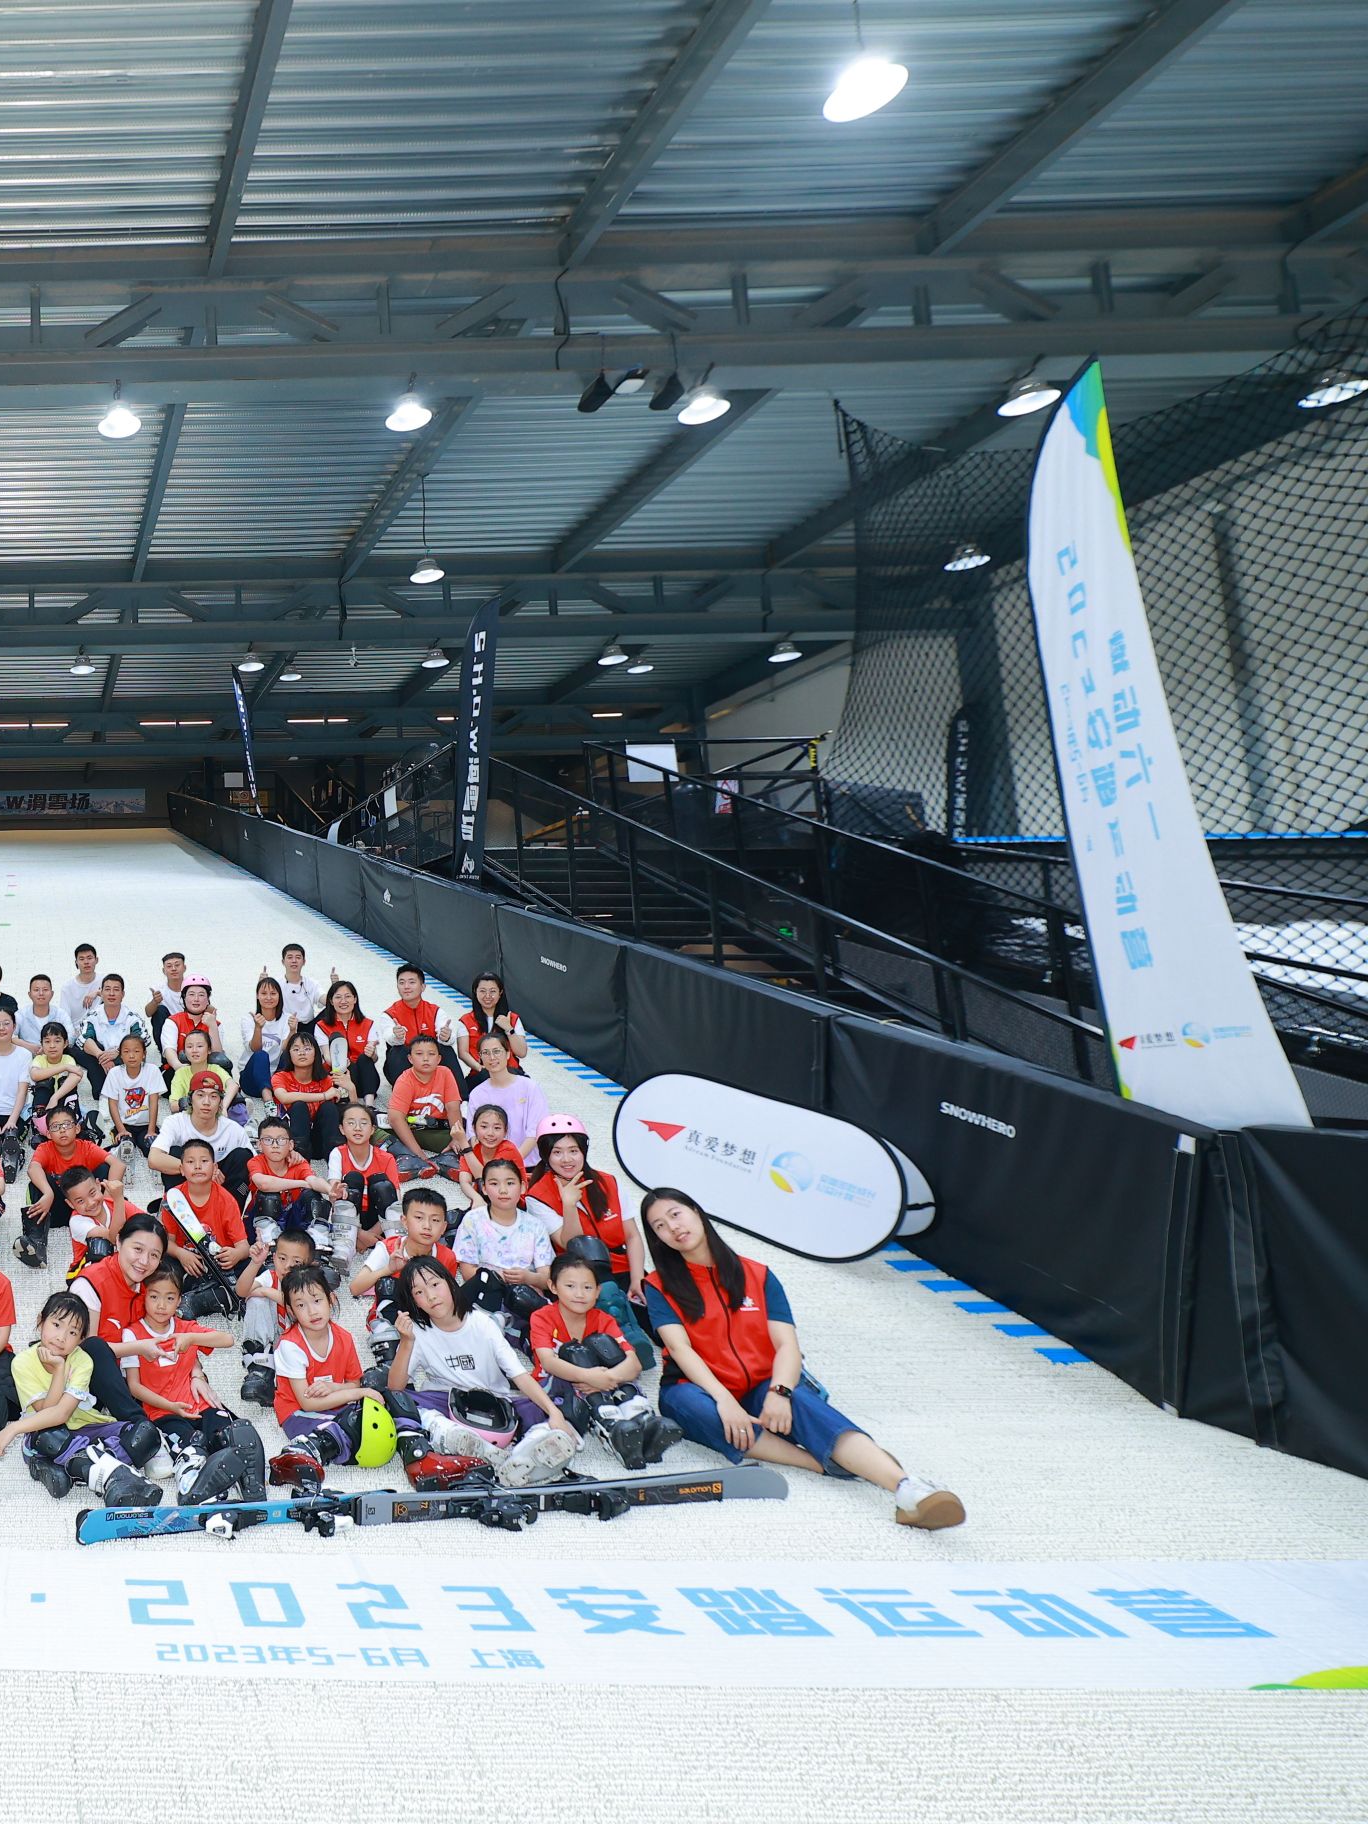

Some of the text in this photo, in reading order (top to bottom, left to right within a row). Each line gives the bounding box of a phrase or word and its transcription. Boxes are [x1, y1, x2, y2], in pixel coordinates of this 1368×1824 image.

[540, 955, 568, 973] SNOWHERO
[939, 1101, 1017, 1139] SNOWHERO
[685, 1128, 757, 1166] 真爱梦想
[444, 1354, 476, 1371] 中國
[158, 1644, 546, 1671] 2023年5-6月 上海
